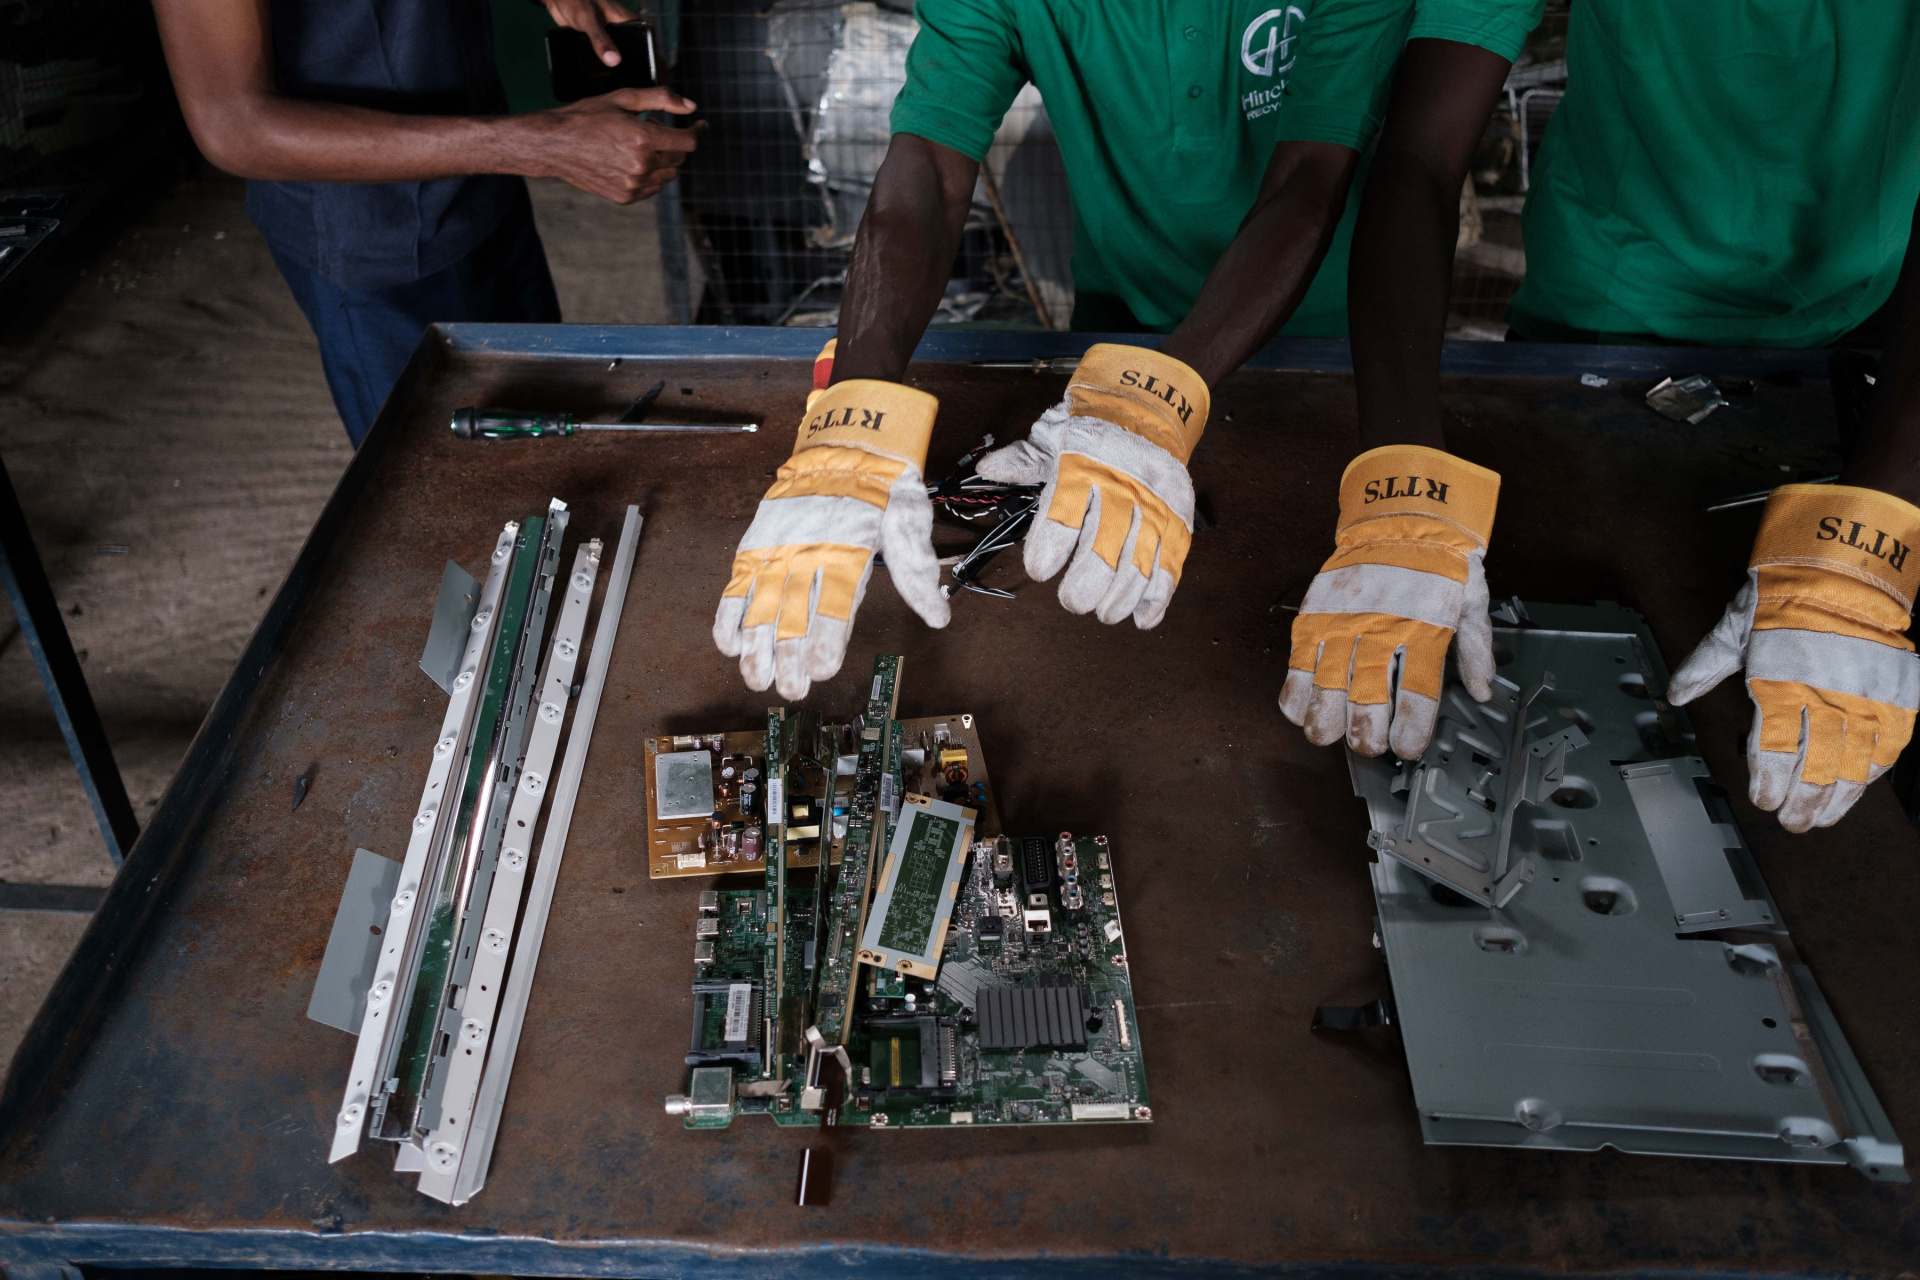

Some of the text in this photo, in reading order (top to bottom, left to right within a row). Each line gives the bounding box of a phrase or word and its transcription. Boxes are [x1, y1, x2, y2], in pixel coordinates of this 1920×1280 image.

[1246, 102, 1281, 120] RECY
[1119, 370, 1194, 427] RTTS
[807, 408, 887, 440] RTTS
[1364, 476, 1450, 505] RTTS
[1816, 516, 1911, 573] RTTS
